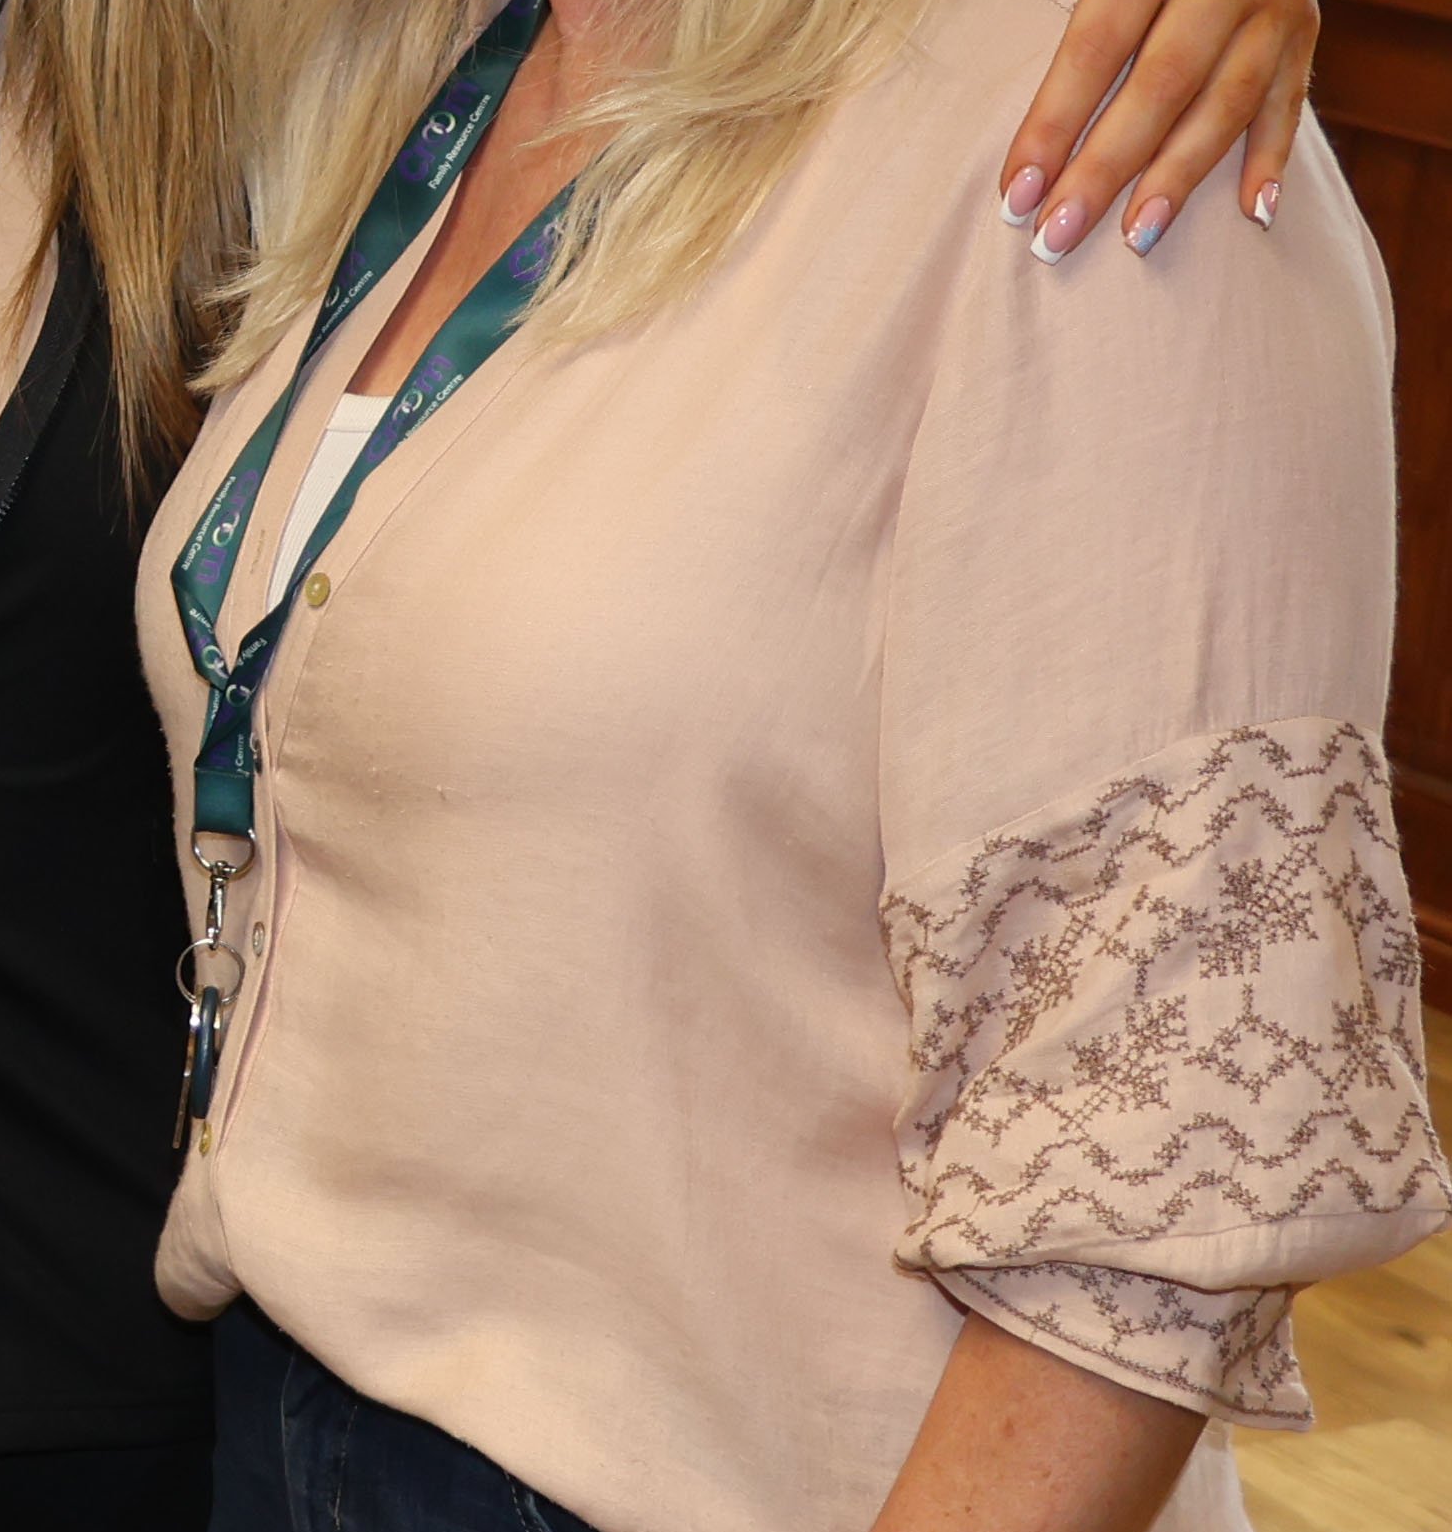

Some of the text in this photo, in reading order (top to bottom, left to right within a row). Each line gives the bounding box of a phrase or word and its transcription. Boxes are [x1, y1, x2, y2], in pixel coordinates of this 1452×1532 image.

[427, 94, 492, 190] Family Resource Centre
[348, 269, 374, 298] Centre
[435, 373, 465, 401] Centre
[196, 469, 259, 584] Croom
[181, 542, 202, 571] Centre
